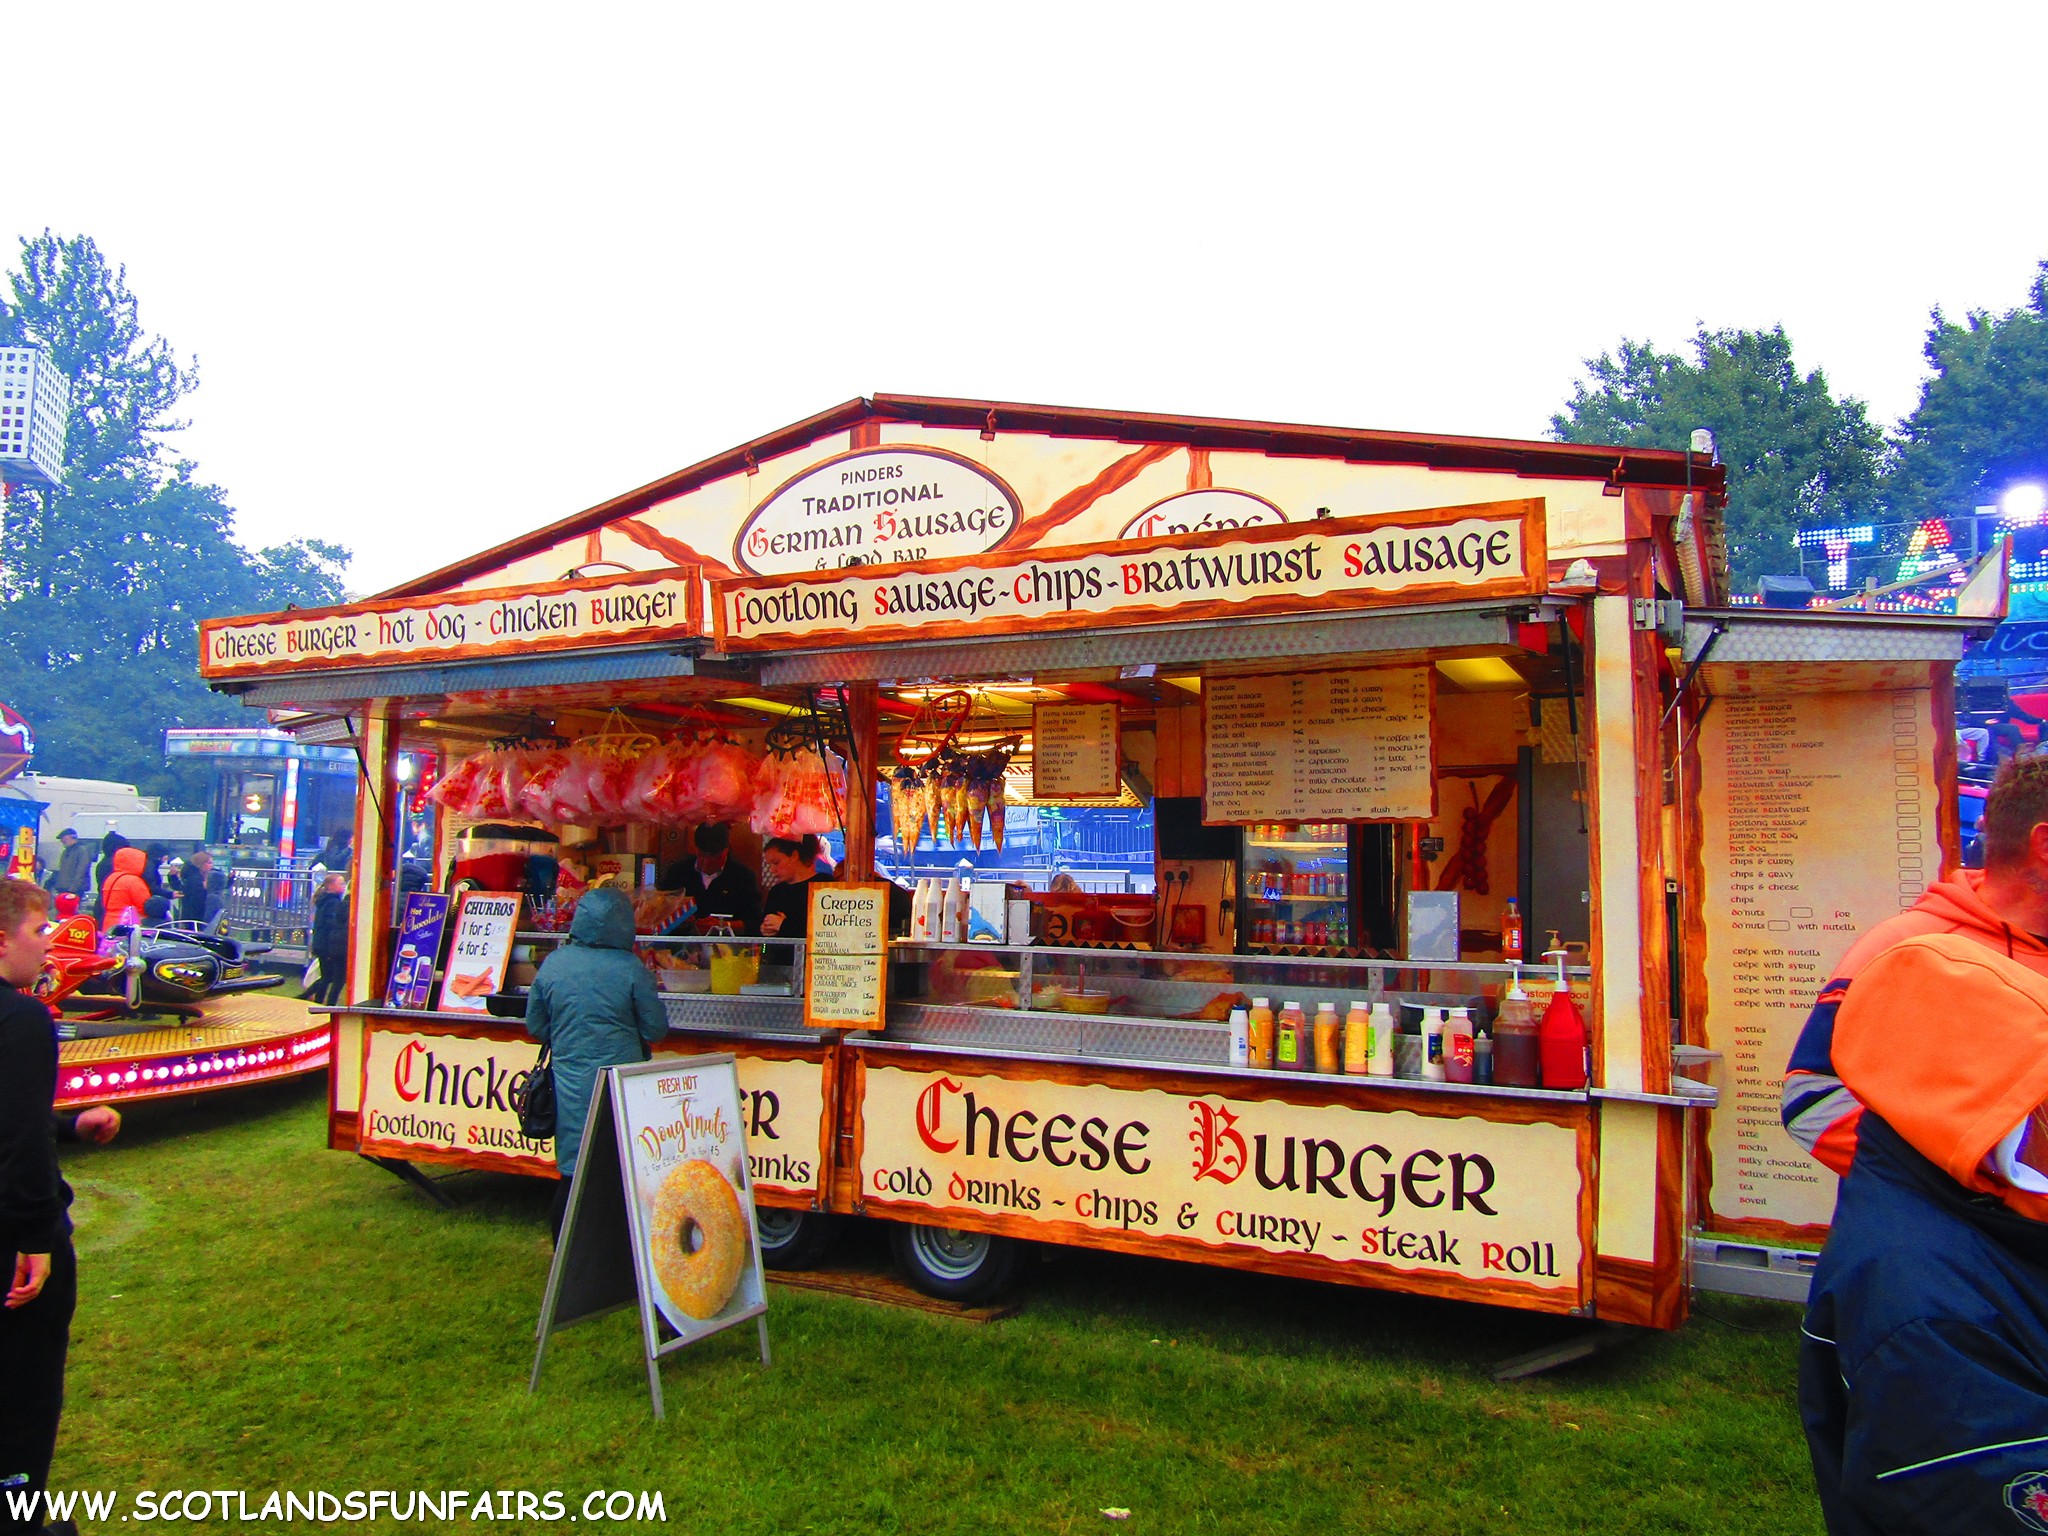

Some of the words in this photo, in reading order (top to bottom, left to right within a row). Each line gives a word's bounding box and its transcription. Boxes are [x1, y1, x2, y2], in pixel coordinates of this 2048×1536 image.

[841, 464, 903, 485] PINDERS
[802, 482, 944, 516] TRADITIONAL
[735, 587, 858, 633] footlong
[820, 894, 875, 914] Crepes
[1730, 896, 1755, 904] chips
[464, 901, 515, 916] CHURROS
[822, 913, 873, 928] Waffles
[68, 928, 90, 940] TOY
[469, 921, 483, 936] for
[465, 941, 480, 956] for
[1763, 961, 1785, 969] with
[1764, 974, 1785, 982] with
[1764, 987, 1786, 996] with
[1764, 1000, 1786, 1009] with
[656, 1077, 681, 1095] FRESH
[681, 1075, 698, 1091] HOT
[369, 1109, 455, 1146] footlong
[638, 1098, 728, 1161] Doughnuts
[1766, 1159, 1812, 1169] chocolate
[1772, 1173, 1819, 1183] chocolate
[1177, 1202, 1199, 1231] &
